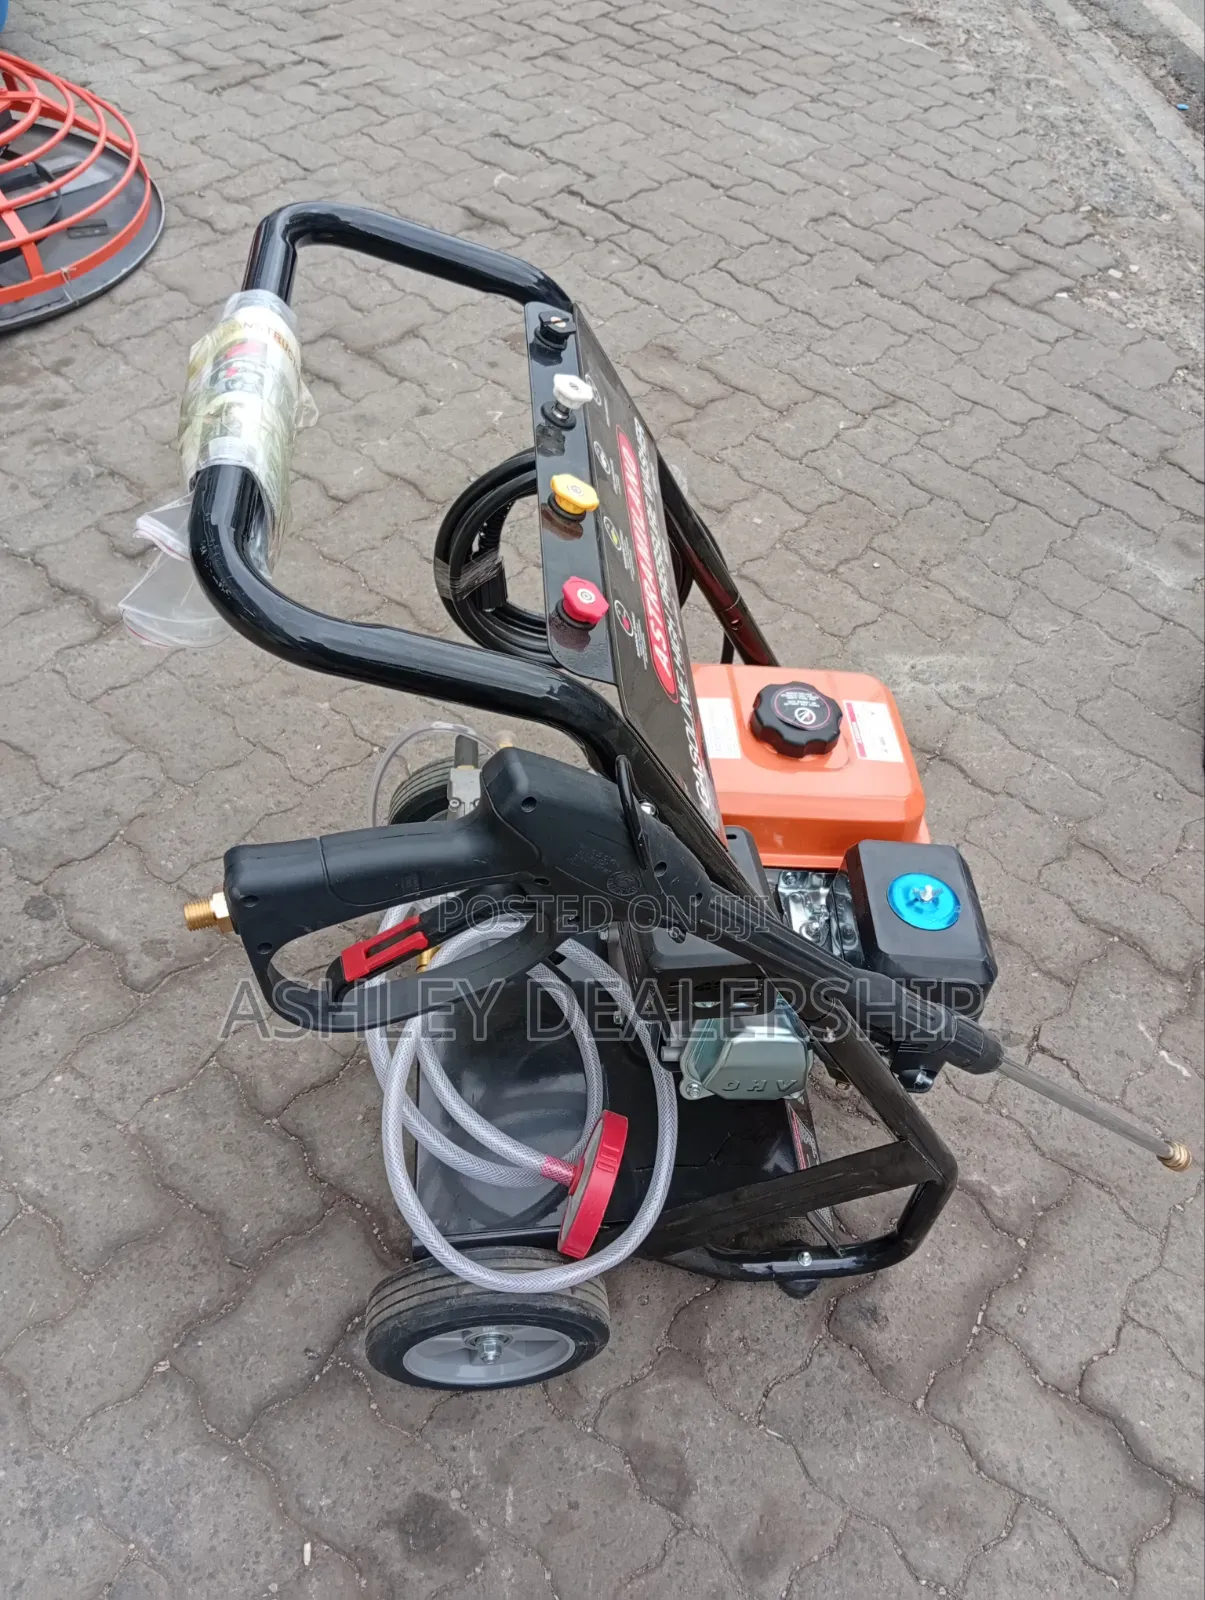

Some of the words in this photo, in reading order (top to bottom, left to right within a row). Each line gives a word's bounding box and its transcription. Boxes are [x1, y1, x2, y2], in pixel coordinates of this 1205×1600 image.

[621, 445, 672, 678] ASTRAMILANO
[664, 608, 685, 676] HIGH
[675, 668, 711, 811] GASOLINE
[721, 1079, 798, 1093] OHV
